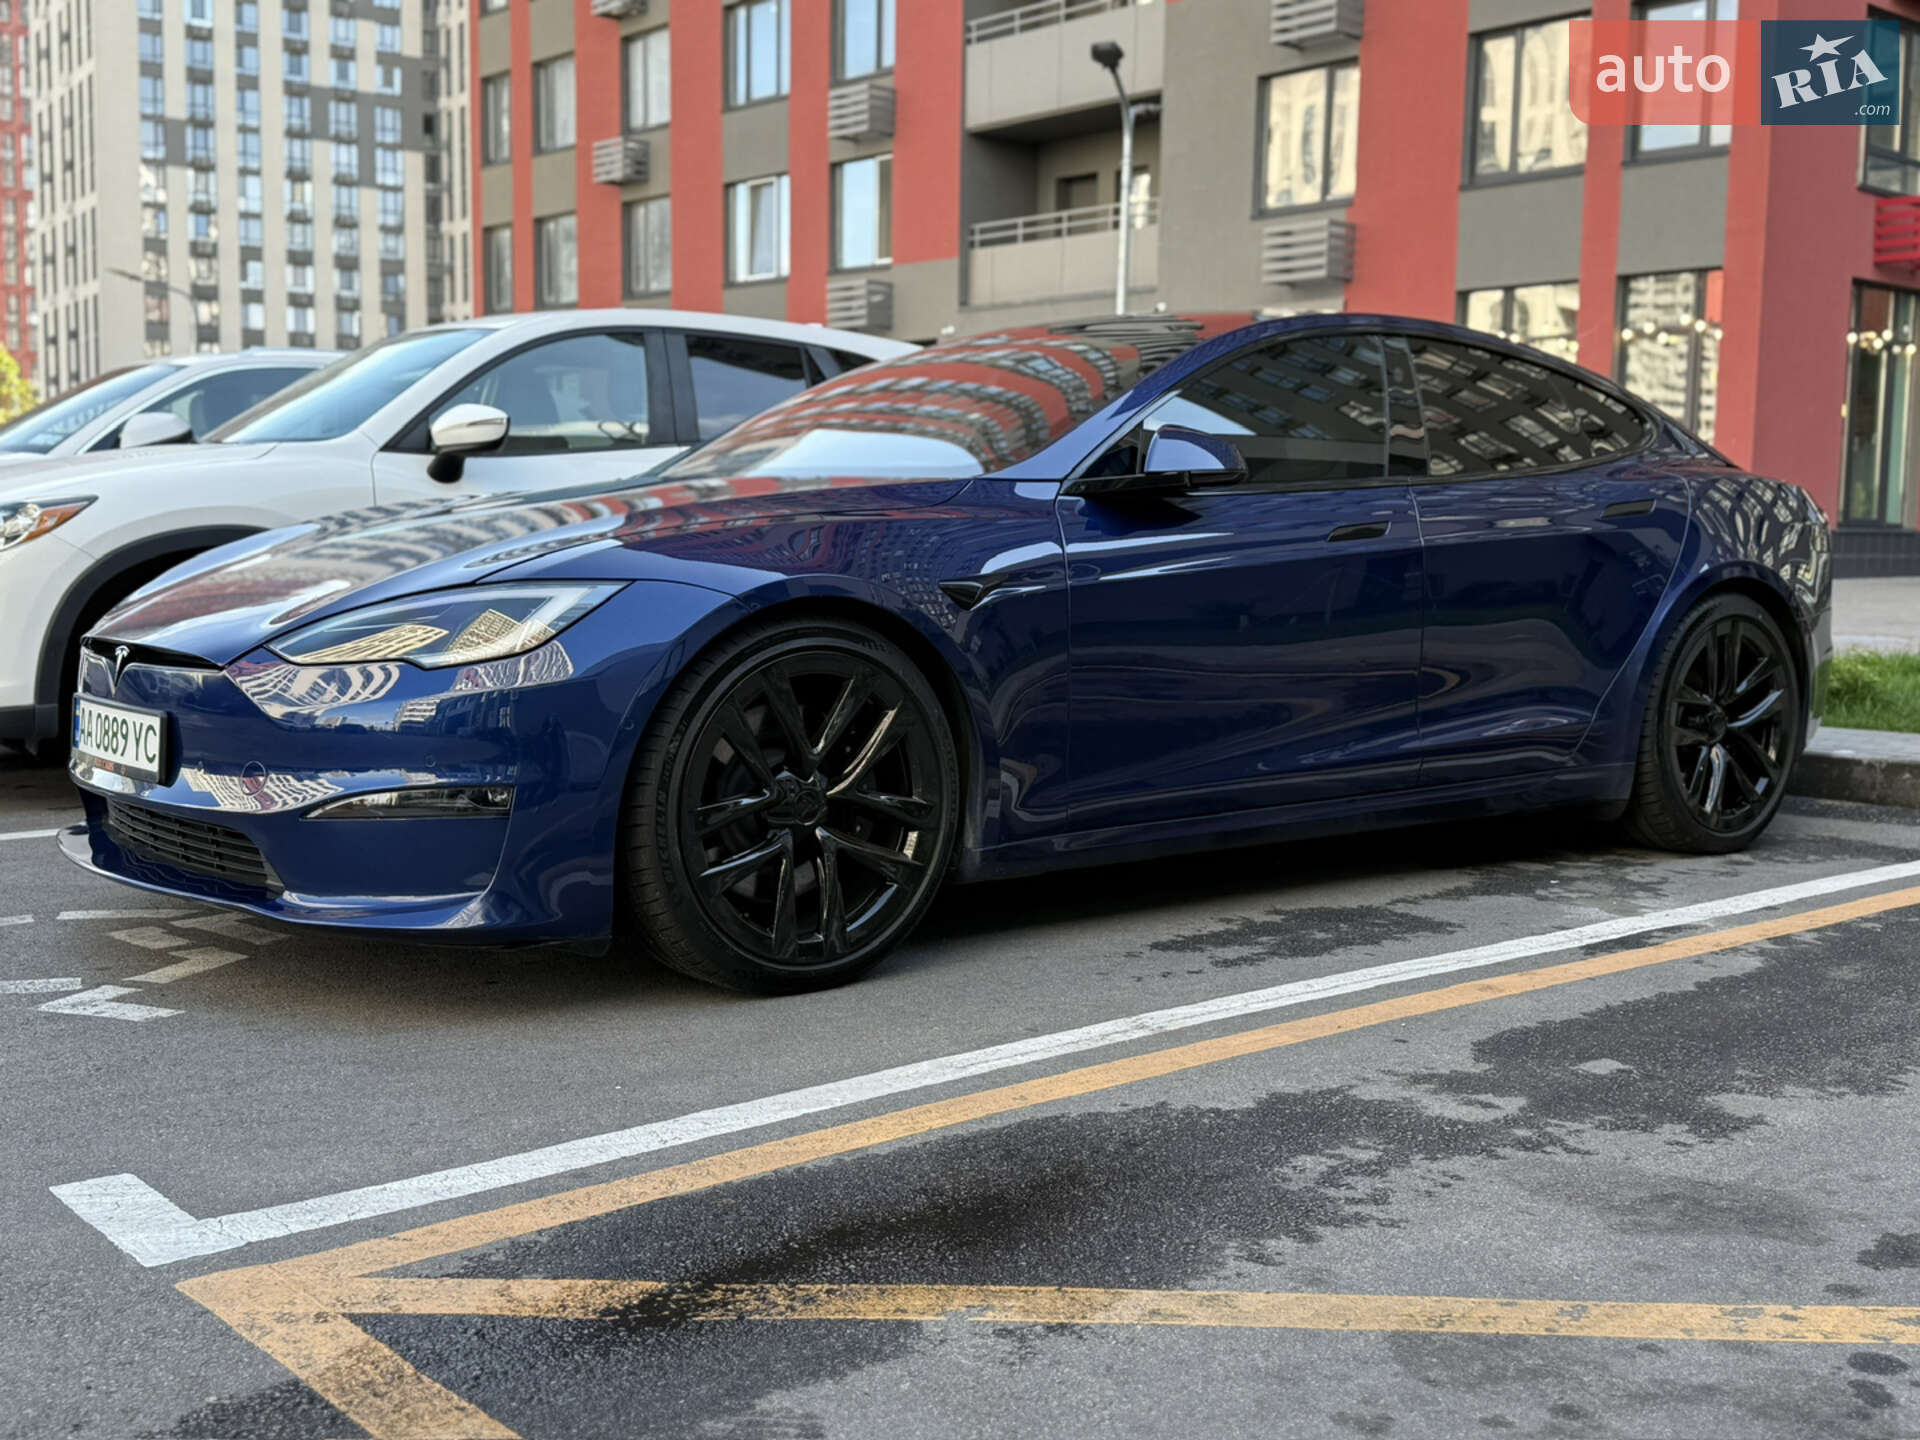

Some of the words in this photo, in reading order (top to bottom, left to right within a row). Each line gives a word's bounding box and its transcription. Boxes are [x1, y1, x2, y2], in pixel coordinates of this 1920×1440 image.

[80, 706, 93, 749] AA
[95, 711, 129, 757] 0889
[132, 720, 157, 764] YC
